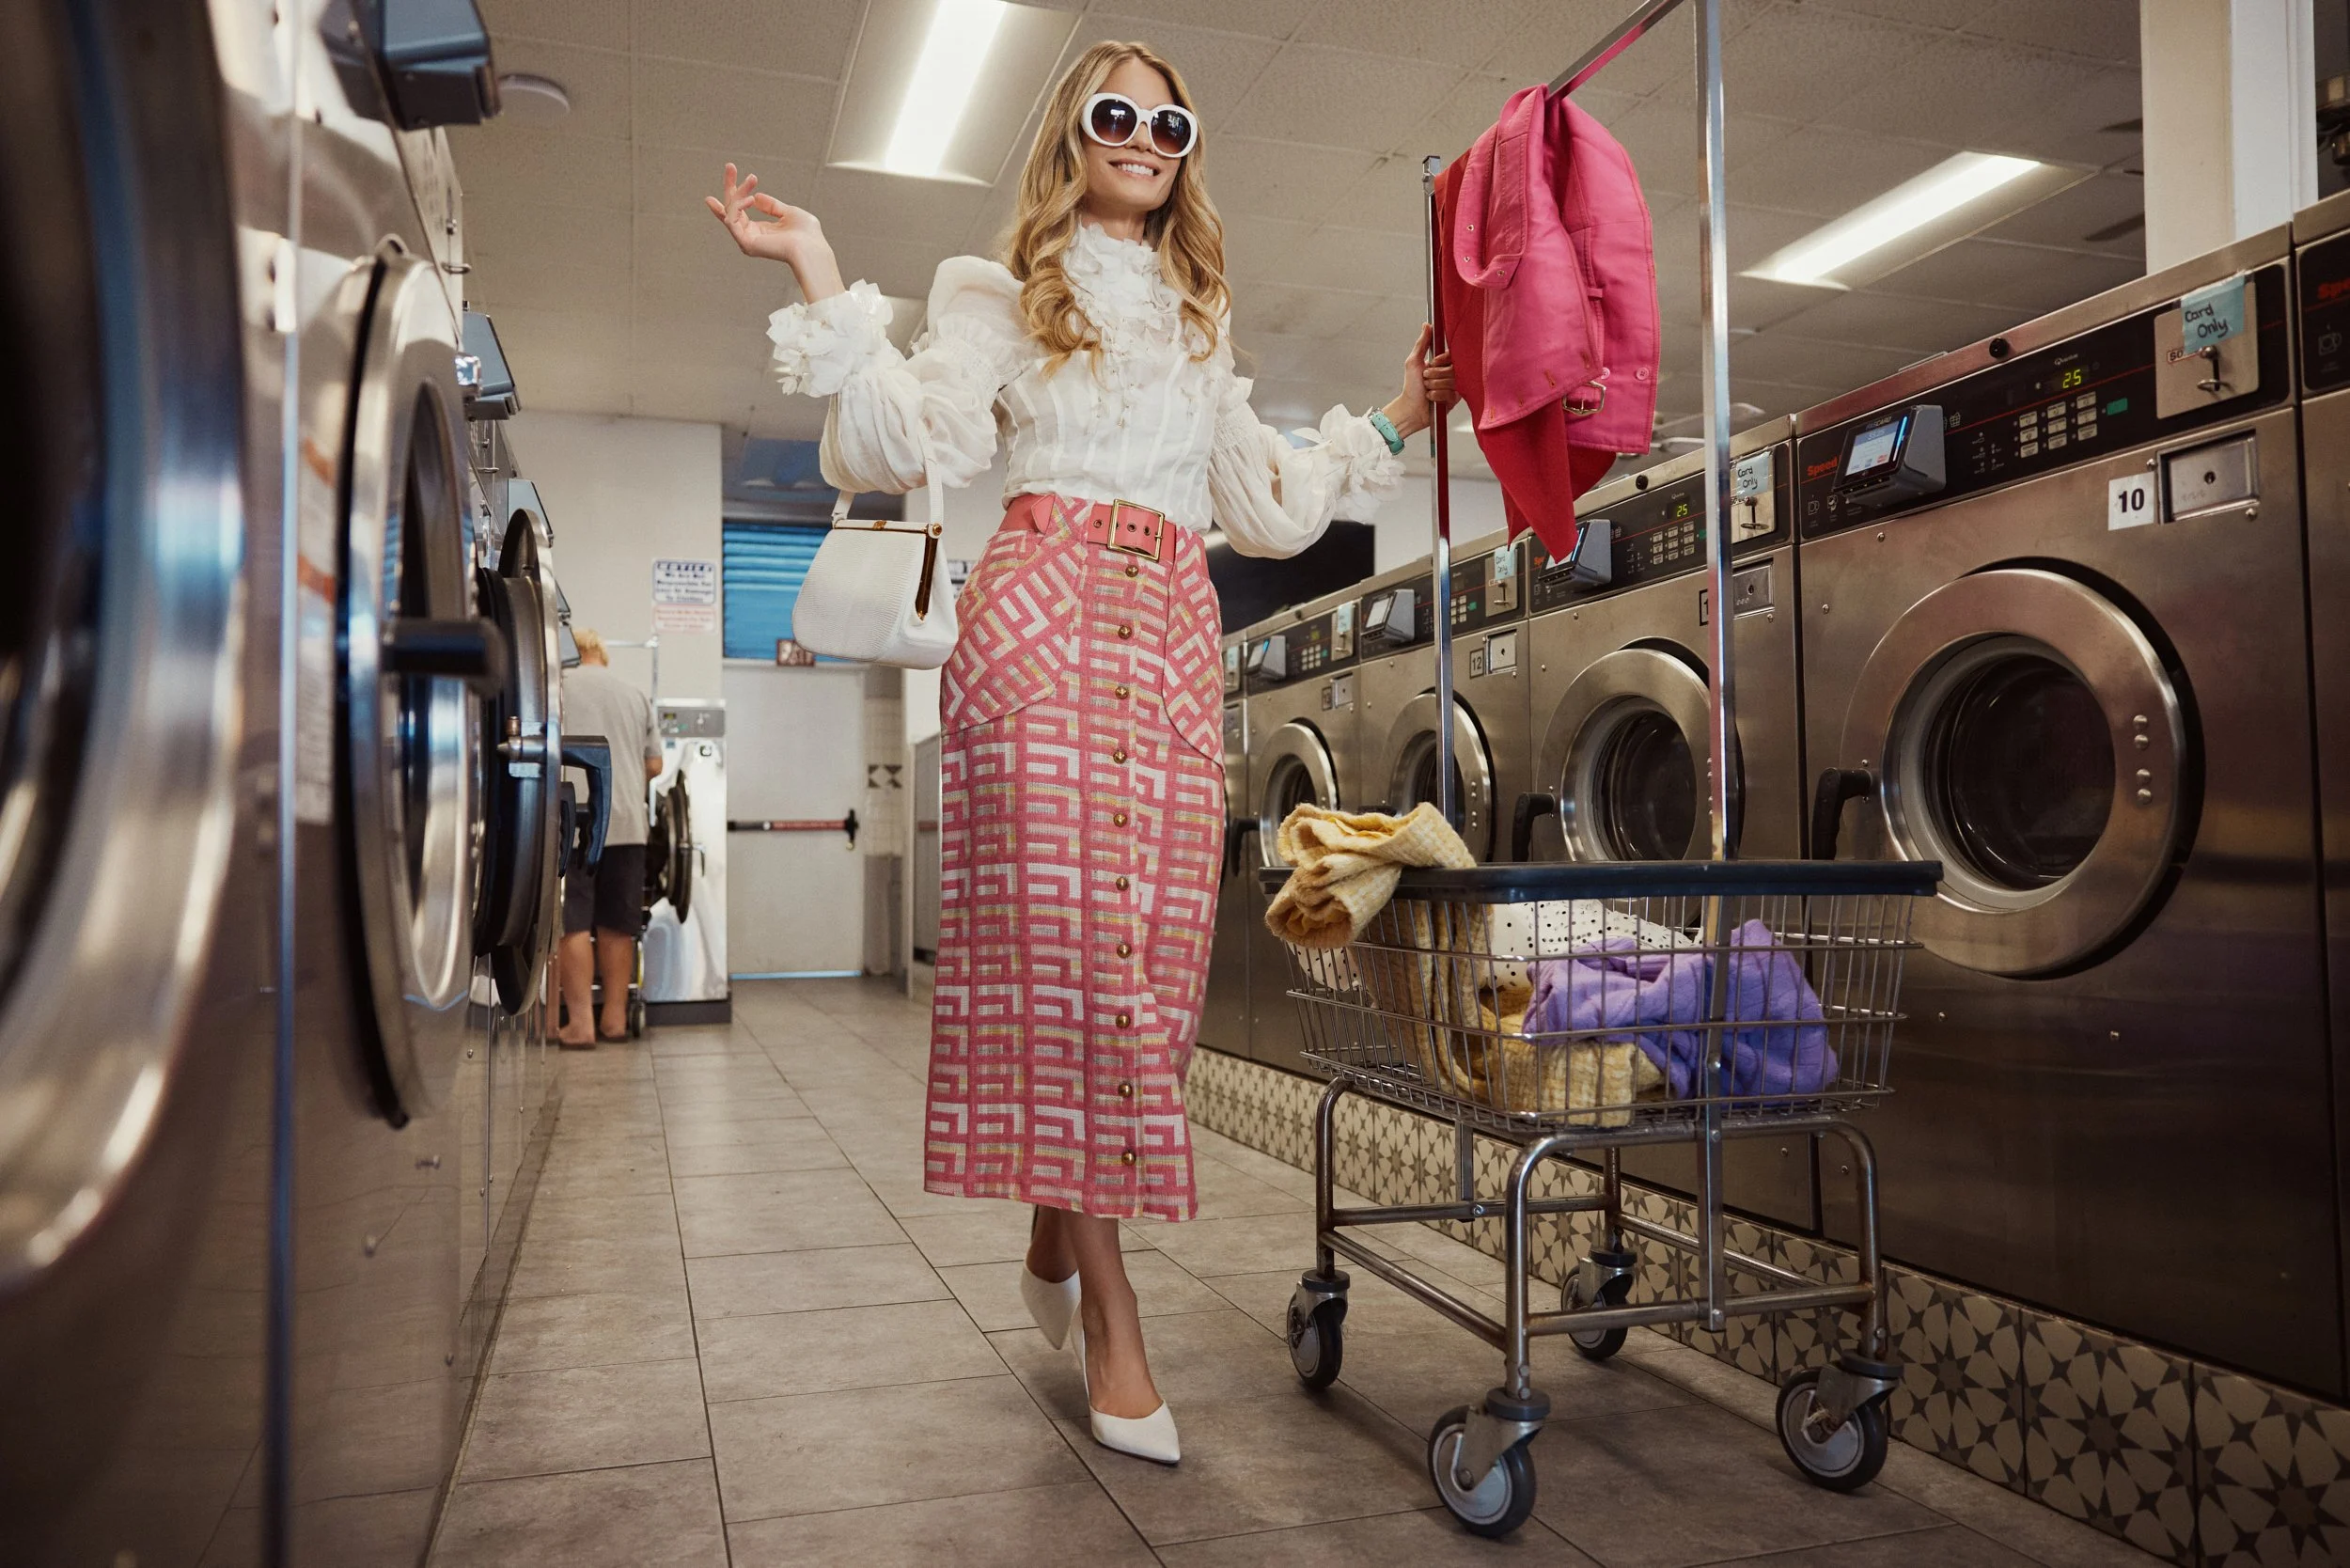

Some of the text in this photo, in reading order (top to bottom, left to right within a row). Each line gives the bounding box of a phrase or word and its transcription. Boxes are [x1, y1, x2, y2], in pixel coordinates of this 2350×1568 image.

[2185, 302, 2214, 322] Card
[2198, 318, 2229, 338] Only
[2062, 368, 2081, 388] 25
[1737, 466, 1754, 478] Card
[1807, 456, 1838, 477] Speed
[1742, 478, 1758, 491] Only
[1676, 503, 1688, 517] 25
[2118, 488, 2145, 513] 10
[1472, 656, 1482, 671] 12
